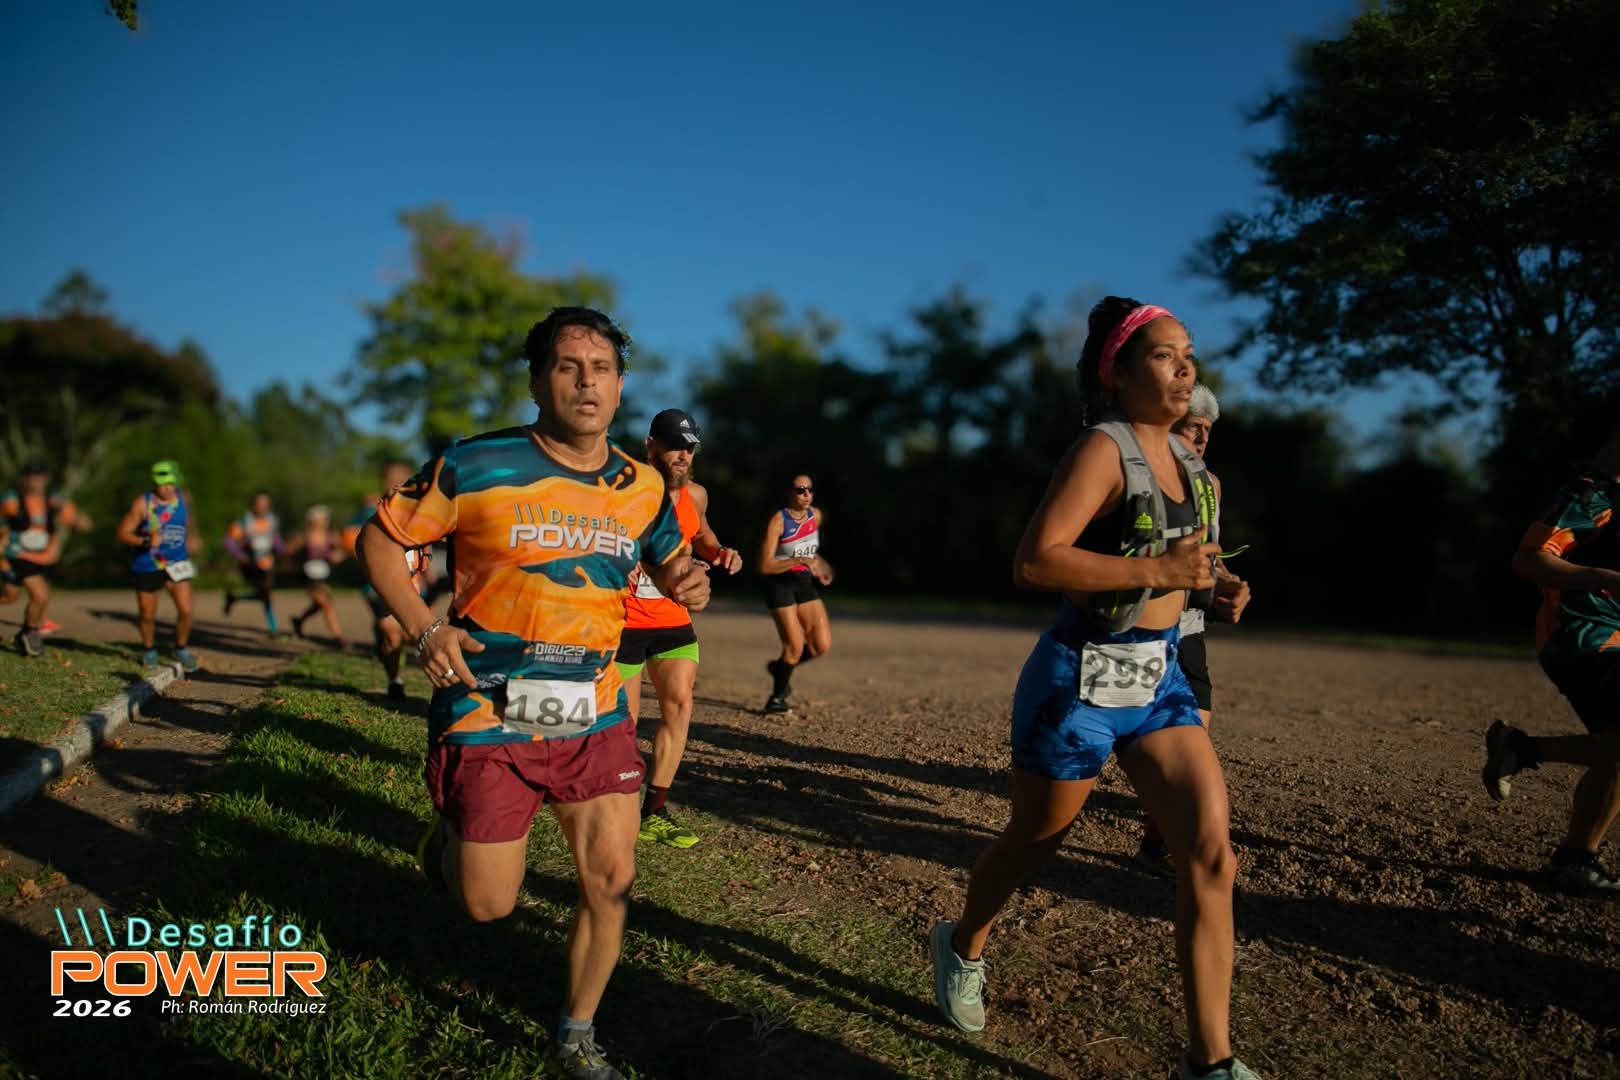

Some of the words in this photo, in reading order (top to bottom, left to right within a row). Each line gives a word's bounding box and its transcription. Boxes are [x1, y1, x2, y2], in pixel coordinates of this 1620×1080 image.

[510, 523, 635, 560] POWER
[1083, 654, 1163, 689] 298
[505, 694, 595, 727] 184
